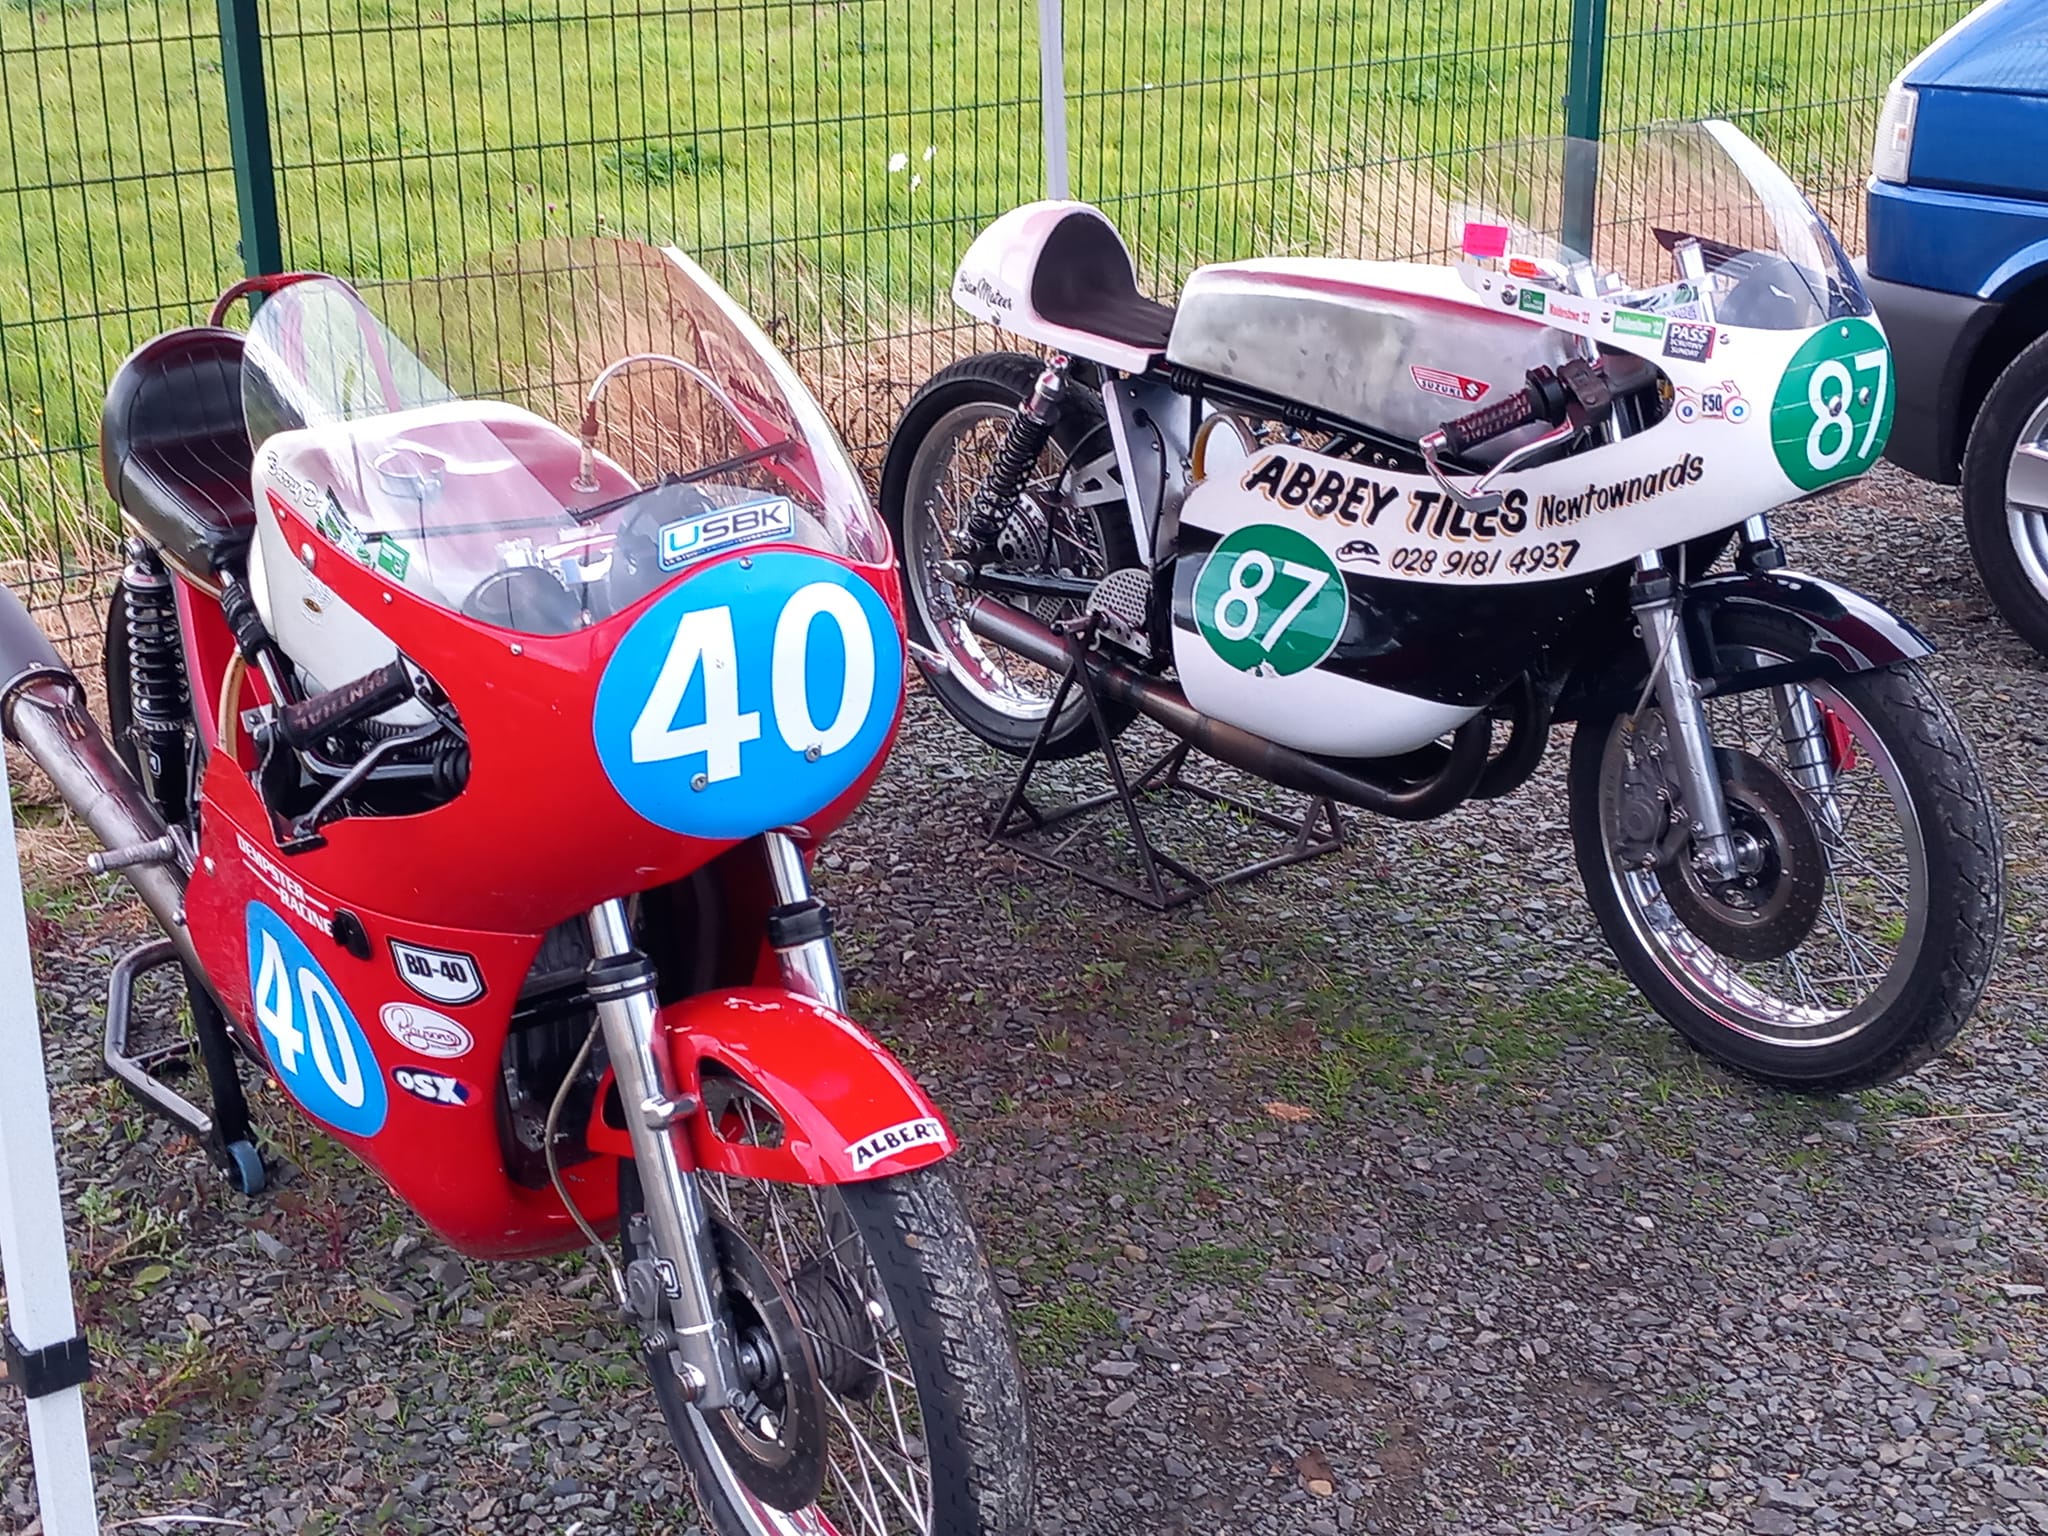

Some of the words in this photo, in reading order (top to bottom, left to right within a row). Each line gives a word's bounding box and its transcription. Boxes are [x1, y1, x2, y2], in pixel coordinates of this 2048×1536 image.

[1670, 324, 1710, 344] PASS
[1421, 380, 1461, 397] SUZUKI
[1702, 393, 1723, 412] F50
[1807, 348, 1888, 471] 87
[1242, 455, 1399, 527] ABBEY
[1537, 452, 1705, 530] Newtownards
[669, 504, 784, 552] USBK
[1388, 547, 1437, 577] 028
[1440, 549, 1502, 579] 9181
[1507, 538, 1581, 575] 4937
[1214, 549, 1331, 652] 87
[631, 581, 876, 784] 40
[235, 831, 307, 905] DEMPSTER
[403, 952, 468, 984] BD-40
[255, 927, 365, 1109] 40
[855, 1122, 941, 1165] ALBERT
